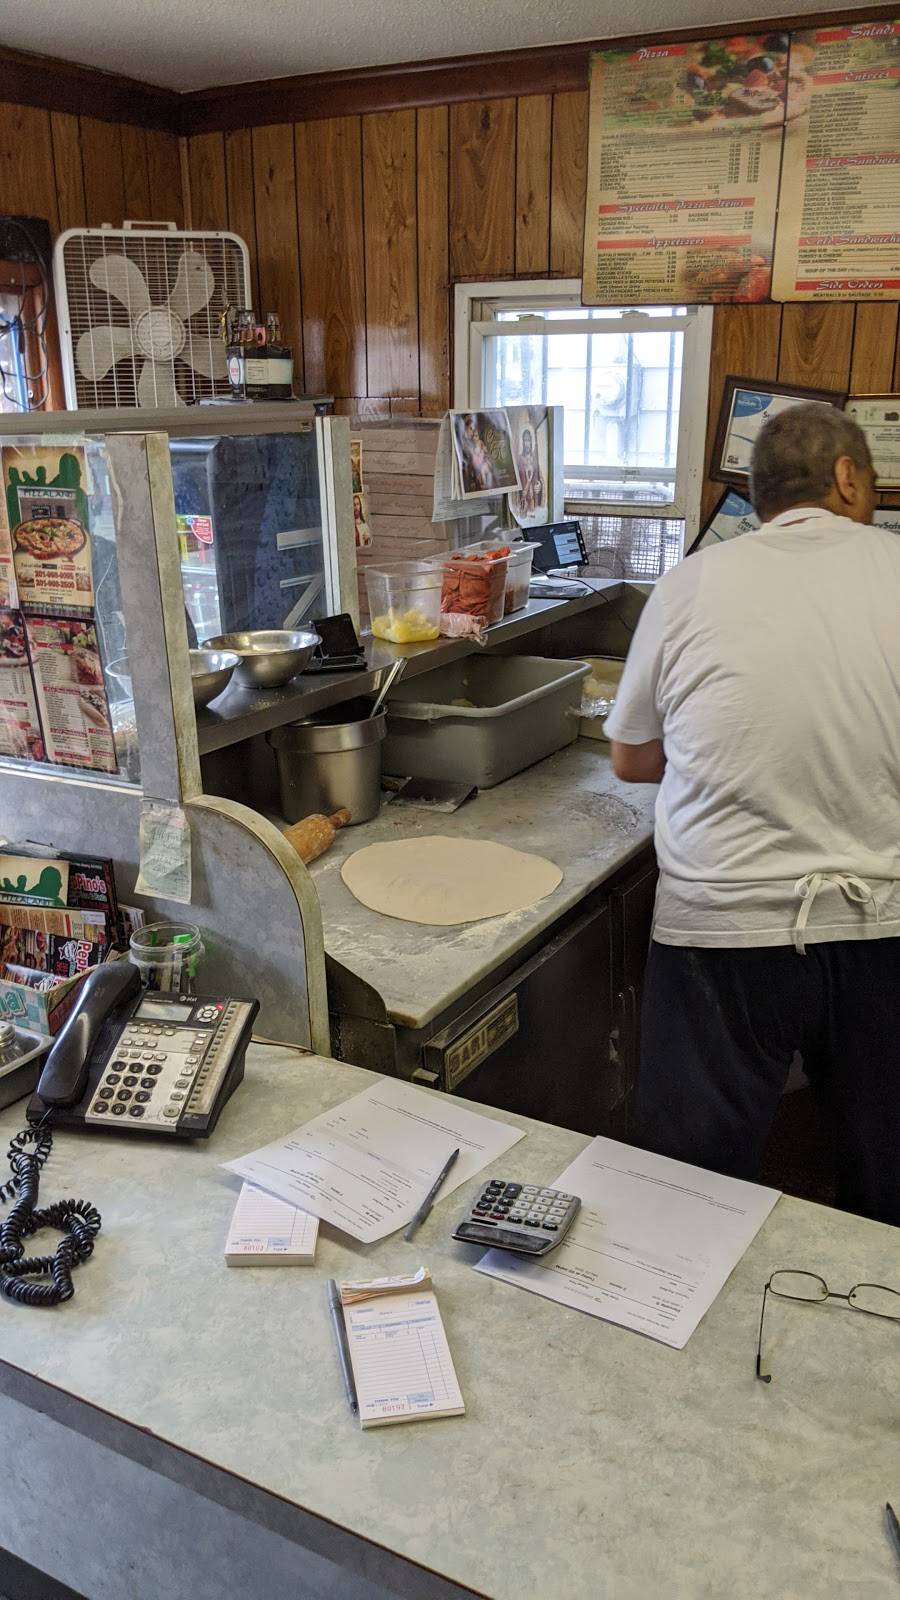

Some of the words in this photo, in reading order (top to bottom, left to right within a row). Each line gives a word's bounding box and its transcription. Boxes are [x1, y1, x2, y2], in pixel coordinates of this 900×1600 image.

[848, 24, 895, 39] Salads
[639, 48, 668, 62] Pizza
[648, 236, 704, 249] Appetizers
